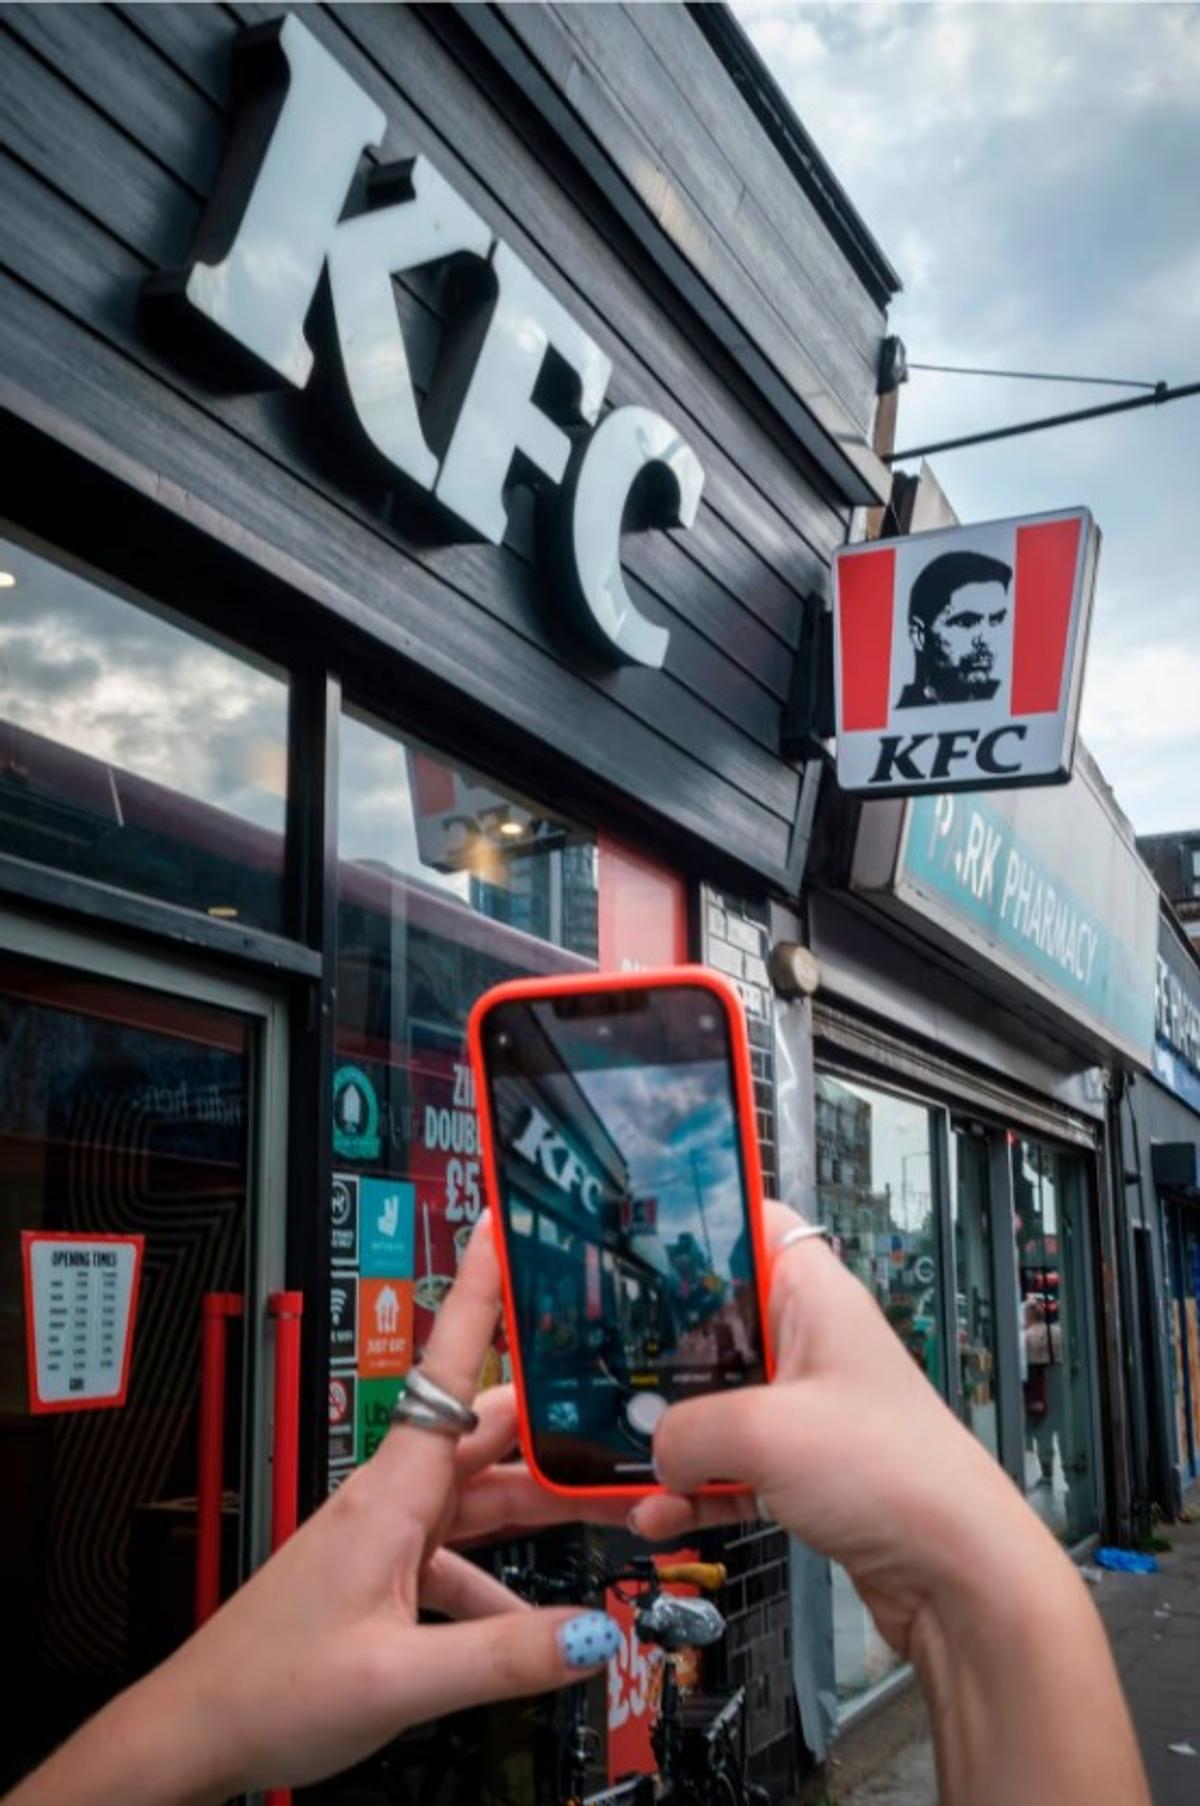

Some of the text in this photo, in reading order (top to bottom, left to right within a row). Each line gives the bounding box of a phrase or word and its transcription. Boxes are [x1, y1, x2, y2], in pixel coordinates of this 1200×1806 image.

[186, 12, 705, 669] KFC
[868, 724, 1028, 784] KFC
[1000, 847, 1098, 985] PHARMACY
[512, 1106, 603, 1215] KFC
[51, 1250, 117, 1268] OPENING TIMES
